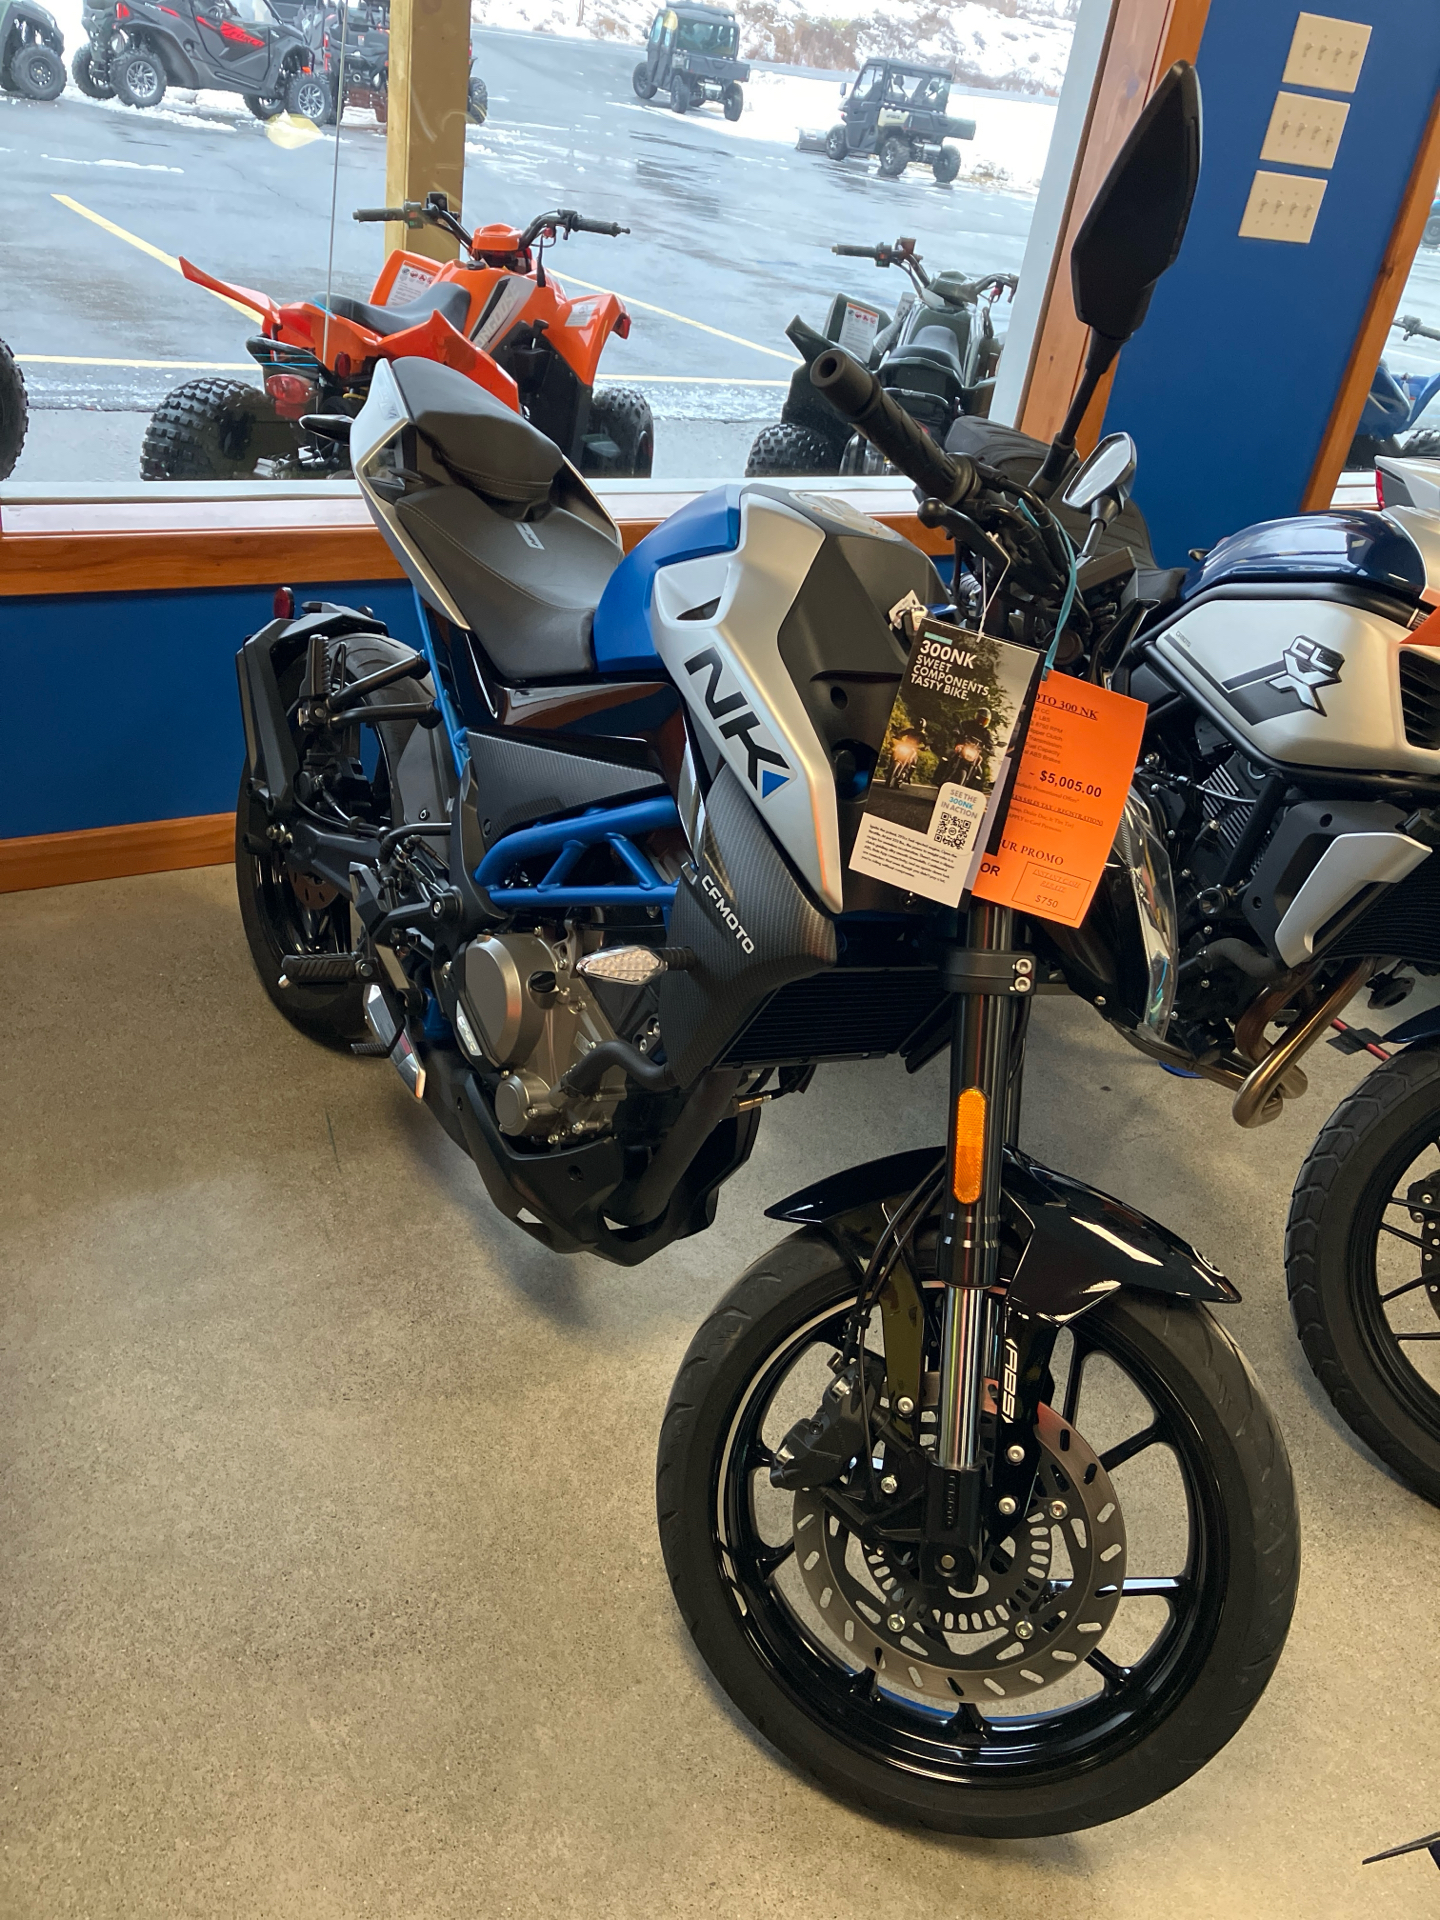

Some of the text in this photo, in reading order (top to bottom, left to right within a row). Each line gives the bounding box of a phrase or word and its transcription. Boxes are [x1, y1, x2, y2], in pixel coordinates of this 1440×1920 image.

[916, 654, 952, 672] SWEET
[920, 640, 977, 669] 300NK
[911, 673, 970, 700] TASTY BIKE.
[684, 646, 790, 792] NK
[1060, 700, 1078, 712] 300
[1080, 706, 1099, 720] NK
[1040, 769, 1102, 797] $5,005.00
[949, 796, 974, 809] 300NK
[950, 789, 977, 803] SEE THE
[941, 801, 978, 819] IN ACTION
[1020, 845, 1064, 866] PROMO
[980, 862, 1000, 876] OR
[1035, 894, 1058, 909] $750
[701, 874, 755, 954] CFMOTO
[1004, 1345, 1018, 1419] ABS
